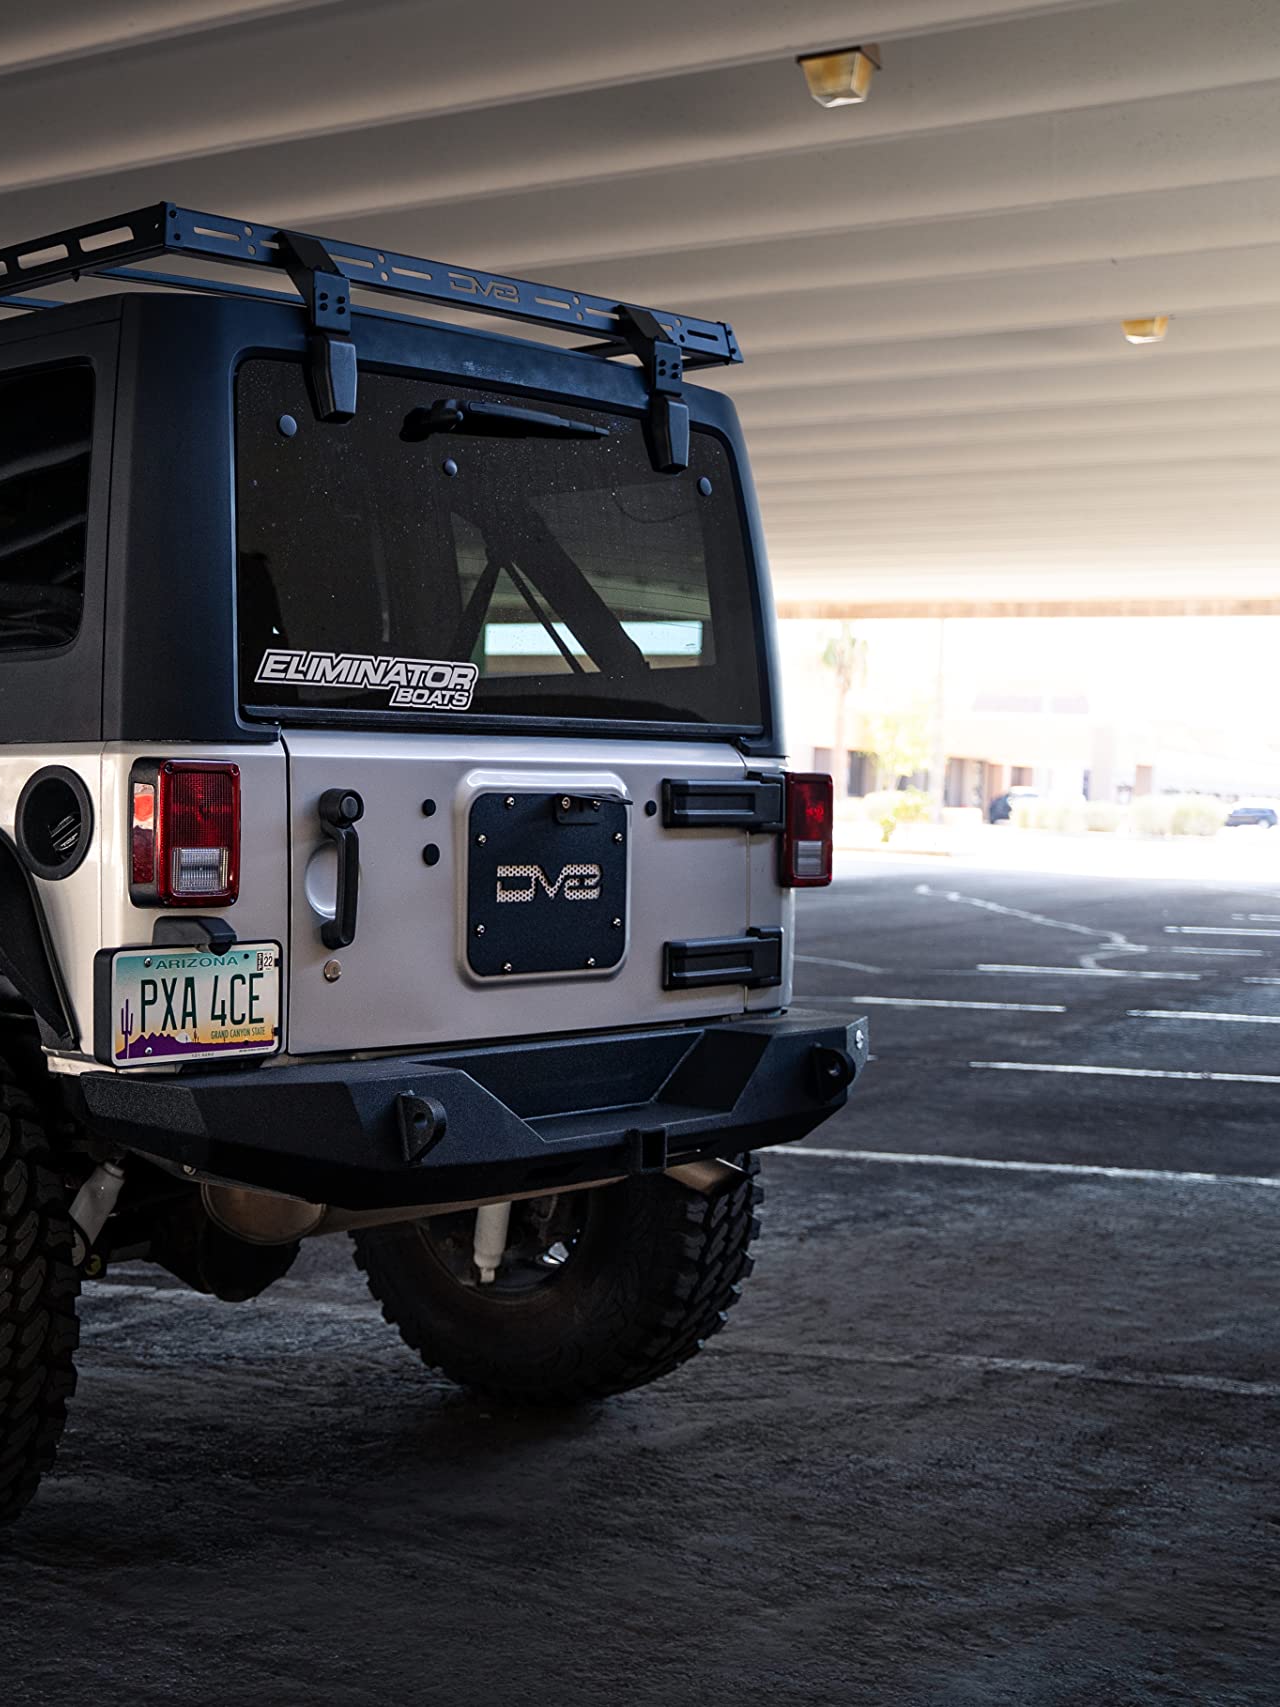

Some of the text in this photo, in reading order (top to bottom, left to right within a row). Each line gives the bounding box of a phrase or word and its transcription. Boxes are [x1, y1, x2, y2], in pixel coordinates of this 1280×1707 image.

[258, 652, 477, 690] ELIMINATOR
[393, 687, 471, 708] BOATS
[155, 956, 238, 969] ARIZONA
[140, 973, 265, 1033] PXA 4CE
[210, 1026, 266, 1040] GRAND CANYON STATE
